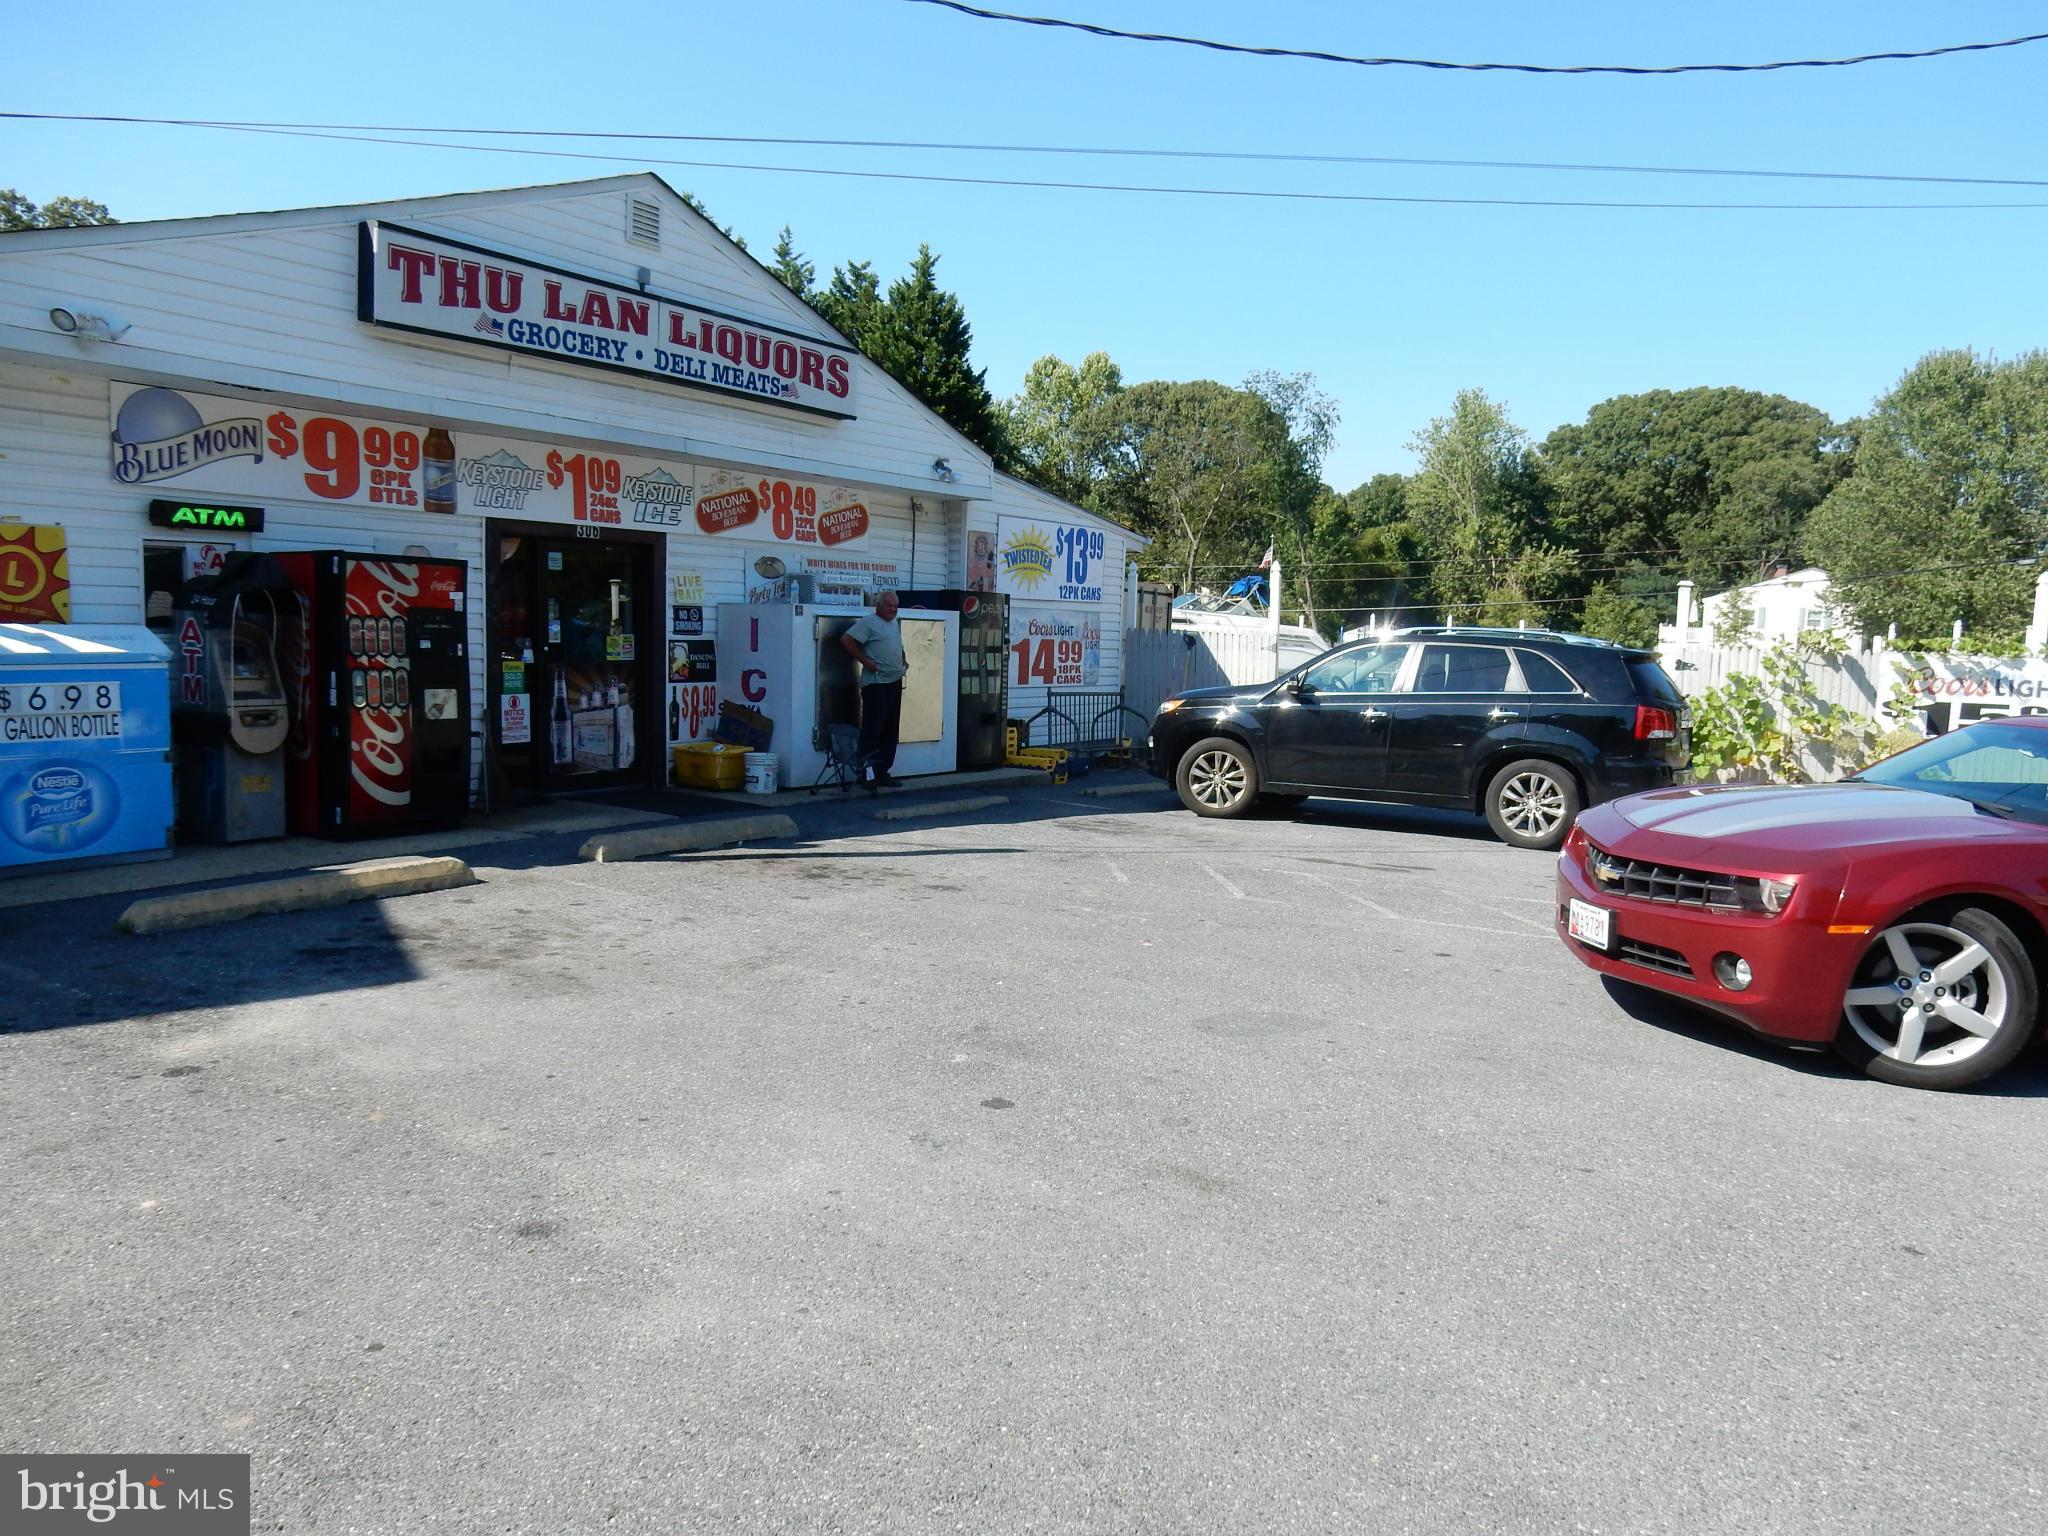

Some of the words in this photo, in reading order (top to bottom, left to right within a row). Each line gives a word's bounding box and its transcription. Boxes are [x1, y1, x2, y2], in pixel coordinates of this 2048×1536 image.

[388, 242, 523, 314] THU
[544, 280, 650, 336] LAN
[669, 311, 850, 399] LIQUORS
[508, 317, 628, 363] GROCERY
[655, 347, 706, 380] DELI
[711, 364, 781, 397] MEATS
[115, 440, 188, 484] BLUE
[193, 424, 258, 456] MOON
[370, 469, 412, 489] 6PK
[369, 486, 418, 507] BTLS
[473, 485, 529, 511] LIGHT
[701, 492, 751, 514] NATIONAL
[171, 507, 246, 528] ATM
[589, 508, 622, 525] CANS
[633, 501, 683, 526] ICE
[712, 505, 747, 521] BOHEMIAN
[822, 507, 863, 528] NATIONAL
[577, 525, 600, 538] 306
[1004, 548, 1040, 569] TWISTED
[677, 575, 702, 587] LIVE
[678, 588, 704, 600] BAIT
[1059, 586, 1079, 600] 12PK
[1080, 587, 1102, 601] CANS
[675, 620, 701, 631] SMOKING
[1054, 625, 1074, 637] LIGHT
[1058, 664, 1081, 674] 18PK
[1057, 674, 1082, 685] CANS
[504, 709, 526, 717] NOTICE
[5, 716, 68, 741] GALLON
[72, 713, 120, 738] BOTTLE
[30, 803, 62, 818] Pure
[63, 796, 87, 811] Life
